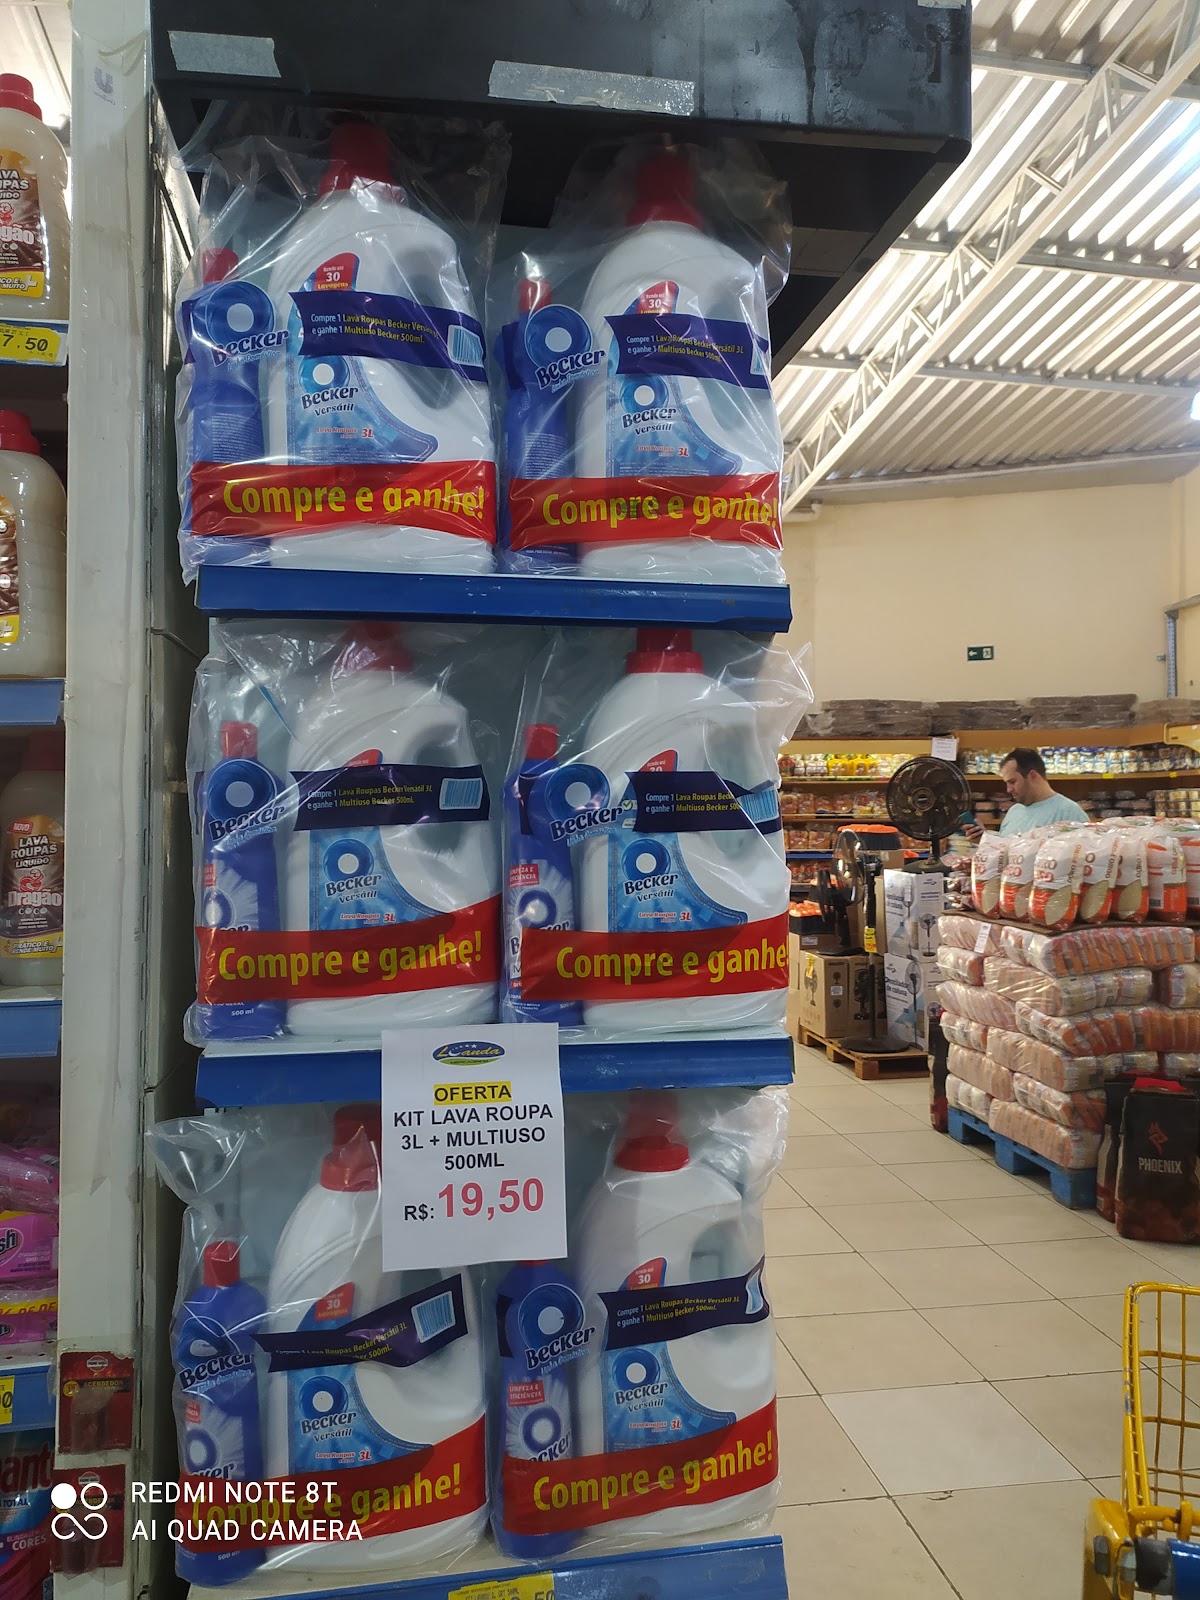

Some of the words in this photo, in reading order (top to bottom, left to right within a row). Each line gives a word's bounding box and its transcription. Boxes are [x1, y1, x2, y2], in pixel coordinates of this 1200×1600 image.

[317, 281, 350, 290] Lavagens
[326, 272, 341, 282] 30
[649, 298, 662, 309] 30
[311, 314, 336, 324] Compre
[337, 313, 341, 322] 1
[343, 313, 360, 323] Lava
[361, 314, 386, 327] Roupas
[387, 320, 411, 331] Becker
[312, 327, 317, 336] e
[317, 325, 338, 338] ganhe
[340, 325, 343, 334] 1
[345, 325, 376, 337] Multiuso
[377, 329, 400, 341] Becker
[210, 330, 290, 367] Becker
[627, 336, 650, 345] Compre
[694, 339, 712, 350] Becker
[632, 345, 652, 356] ganhe
[653, 345, 657, 353] 1
[658, 345, 686, 354] Multiuso
[687, 349, 705, 358] Becker
[535, 350, 606, 389] Becker
[301, 384, 359, 410] Becker
[622, 407, 677, 429] Becker
[361, 427, 375, 439] 3L
[677, 446, 689, 458] 3L
[222, 481, 346, 522] Compre
[354, 486, 375, 513] e
[382, 479, 485, 520] ganhe!
[542, 493, 660, 529] Compre
[667, 495, 685, 520] e
[693, 492, 779, 530] ganhe!
[307, 790, 333, 800] Compre
[334, 789, 338, 797] 1
[339, 788, 355, 797] Lava
[355, 786, 382, 798] Roupas
[383, 785, 404, 794] Becker
[426, 784, 433, 793] 3L
[646, 793, 670, 803] Compre
[671, 793, 675, 801] 1
[676, 793, 691, 801] Lava
[692, 792, 716, 803] Roupas
[307, 802, 312, 810] e
[312, 800, 332, 811] ganhe
[334, 800, 338, 808] 1
[339, 797, 371, 807] Multiuso
[372, 796, 395, 805] Becker
[651, 805, 670, 815] ganhe
[671, 804, 675, 812] 1
[676, 803, 705, 812] Multiuso
[705, 803, 729, 812] Becker
[208, 806, 286, 842] Becker
[549, 805, 623, 841] Becker
[19, 835, 49, 848] LAVA
[10, 844, 58, 860] ROUPAS
[325, 873, 382, 897] Becker
[624, 873, 679, 896] Becker
[8, 888, 63, 907] Dragão
[18, 907, 48, 916] COCO
[383, 912, 397, 923] 3L
[679, 911, 692, 922] 3L
[218, 946, 343, 986] Compre
[351, 949, 371, 974] e
[379, 930, 482, 981] ganhe!
[556, 945, 675, 986] Compre
[681, 950, 699, 976] e
[433, 1083, 512, 1103] OFERTA
[393, 1109, 425, 1128] KIT
[430, 1107, 481, 1125] LAVA
[486, 1103, 554, 1122] ROUPA
[401, 1135, 424, 1151] 3L
[429, 1135, 440, 1147] +
[446, 1126, 546, 1148] MULTIUSO
[444, 1151, 505, 1171] 500ML
[1138, 1156, 1183, 1174] PHOENIX
[404, 1202, 435, 1222] R$:
[437, 1177, 545, 1222] 19,50
[637, 1274, 651, 1285] 30
[326, 1298, 342, 1309] 30
[617, 1307, 639, 1318] Compre
[640, 1306, 644, 1314] 1
[645, 1303, 660, 1312] Lava
[661, 1300, 683, 1311] Roupas
[621, 1317, 640, 1328] ganhe
[641, 1315, 645, 1323] 1
[646, 1312, 674, 1323] Multiuso
[675, 1307, 695, 1318] Becker
[325, 1348, 352, 1356] Roupas
[353, 1339, 377, 1353] Becker
[376, 1326, 400, 1343] Versátil
[400, 1321, 408, 1332] 3L
[368, 1345, 392, 1360] 500ml.
[525, 1325, 597, 1371] Becker
[177, 1352, 255, 1388] Becker
[614, 1381, 669, 1406] Becker
[301, 1411, 358, 1435] Becker
[670, 1419, 682, 1431] 3L
[358, 1450, 372, 1461] 3L
[533, 1464, 650, 1511] Compre
[657, 1465, 675, 1490] e
[682, 1429, 773, 1495] ganhe!
[190, 1494, 314, 1535] Compre
[323, 1490, 343, 1517] e
[351, 1462, 461, 1524] ganhe!
[12, 1532, 48, 1550] CORES
